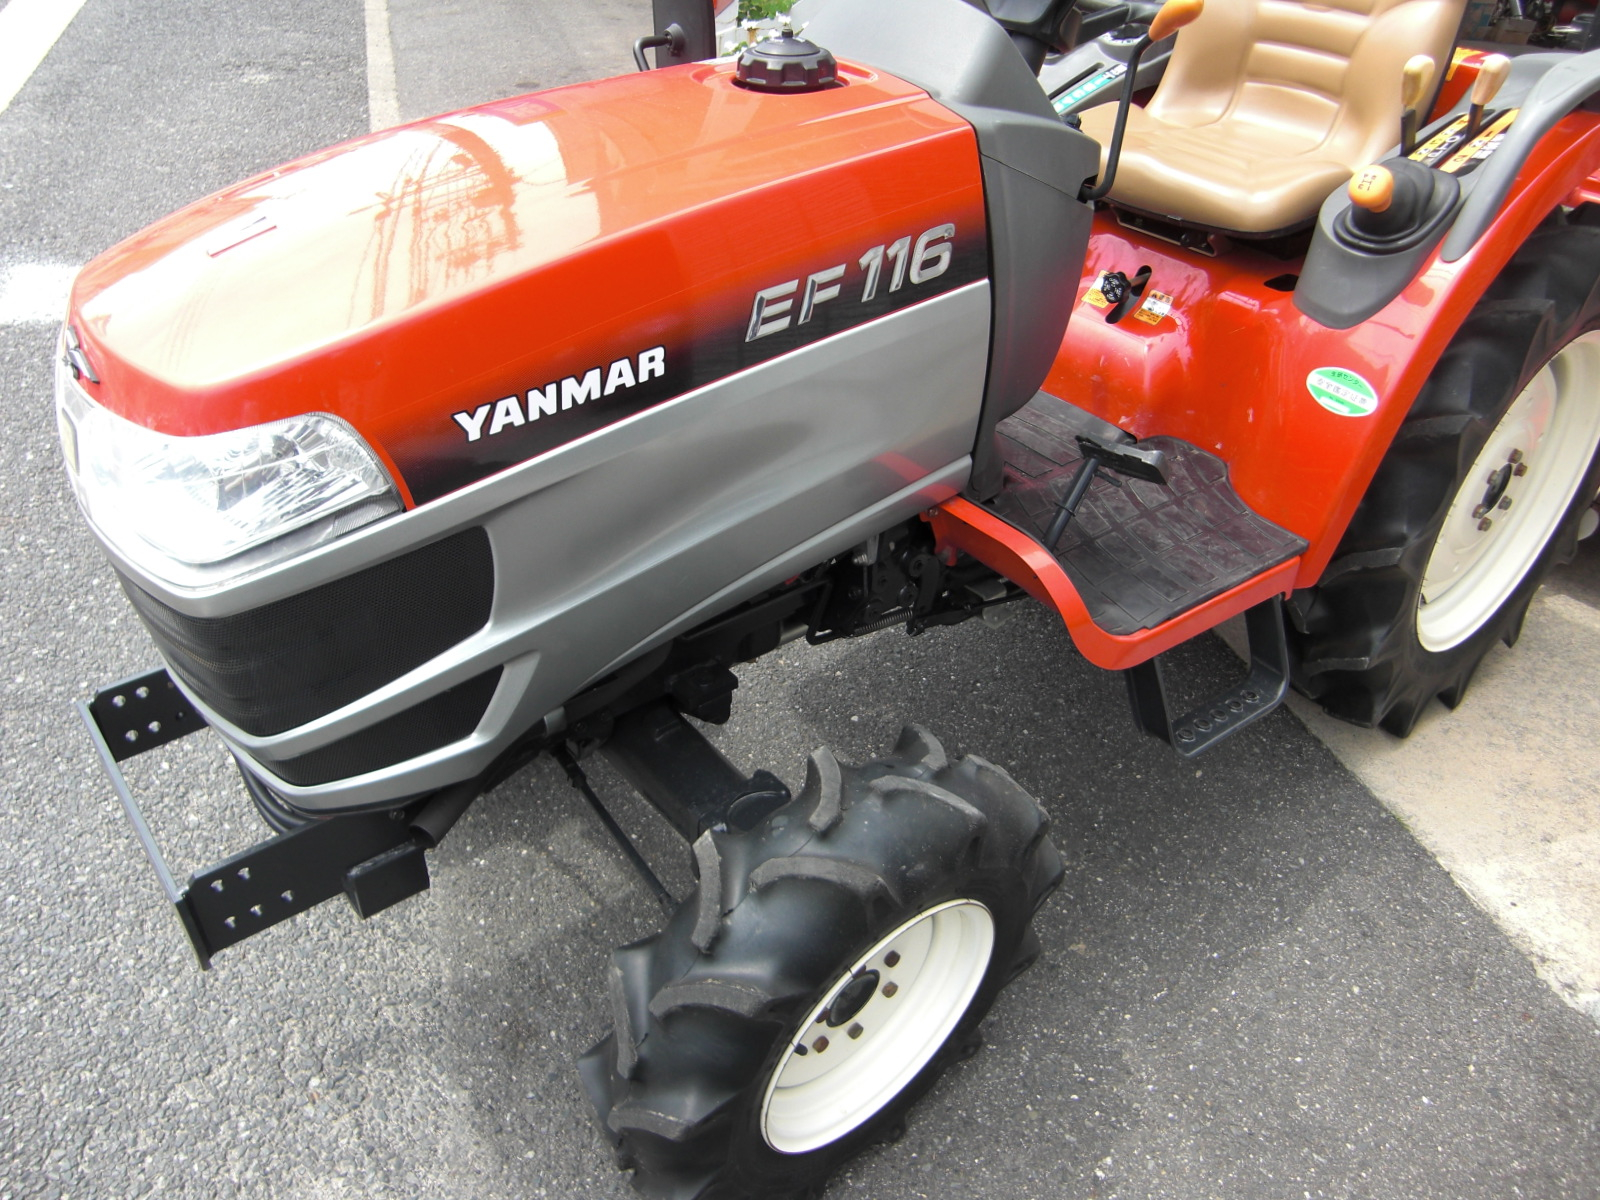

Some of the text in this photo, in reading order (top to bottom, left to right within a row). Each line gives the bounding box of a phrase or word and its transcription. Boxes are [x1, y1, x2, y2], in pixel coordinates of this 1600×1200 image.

[745, 223, 956, 343] EF 116
[452, 345, 665, 442] YANMAR
